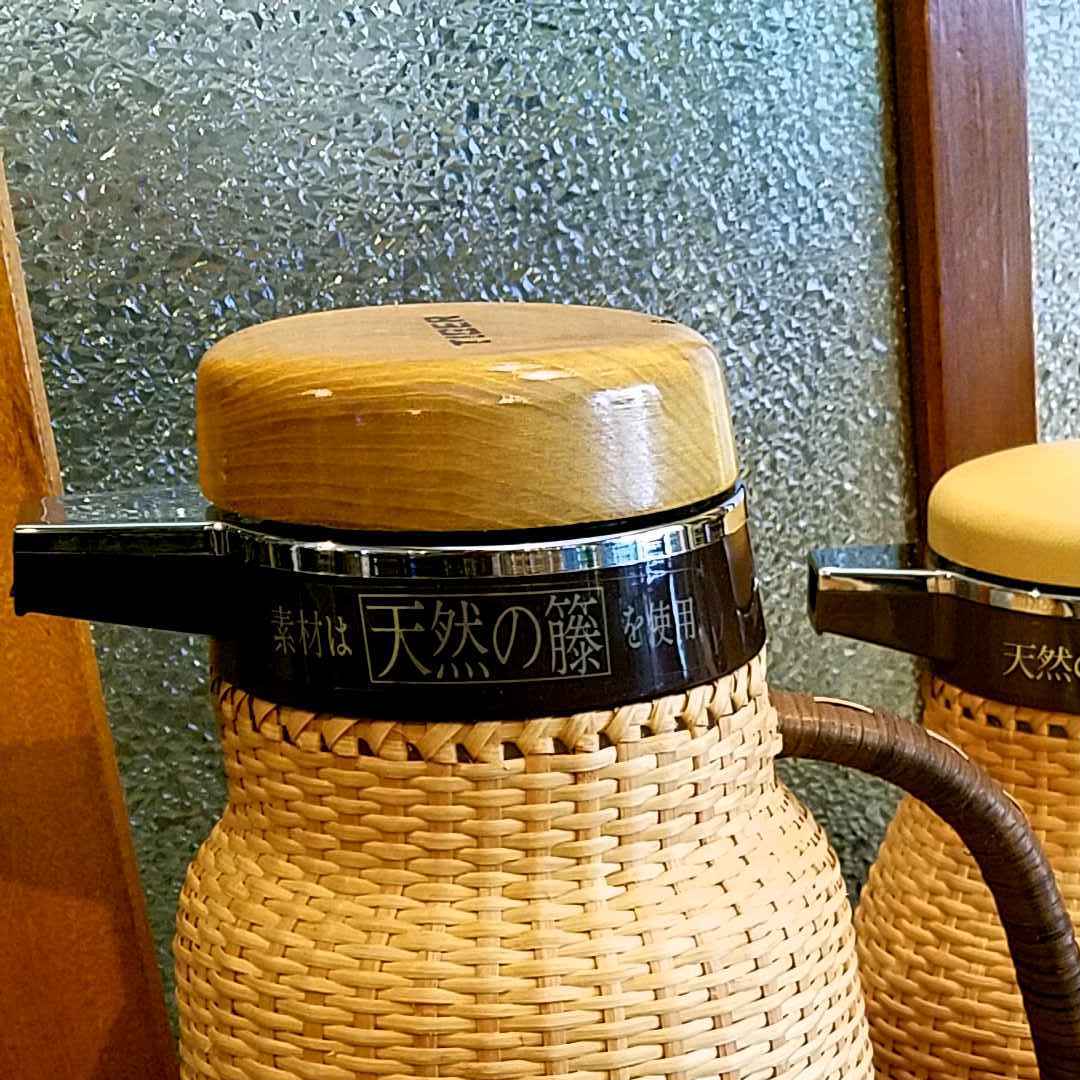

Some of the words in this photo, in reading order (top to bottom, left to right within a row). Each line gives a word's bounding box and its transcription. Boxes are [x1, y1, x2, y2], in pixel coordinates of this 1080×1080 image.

[271, 604, 353, 657] 素材は
[366, 594, 604, 679] 天然の籐
[622, 597, 696, 649] を使用
